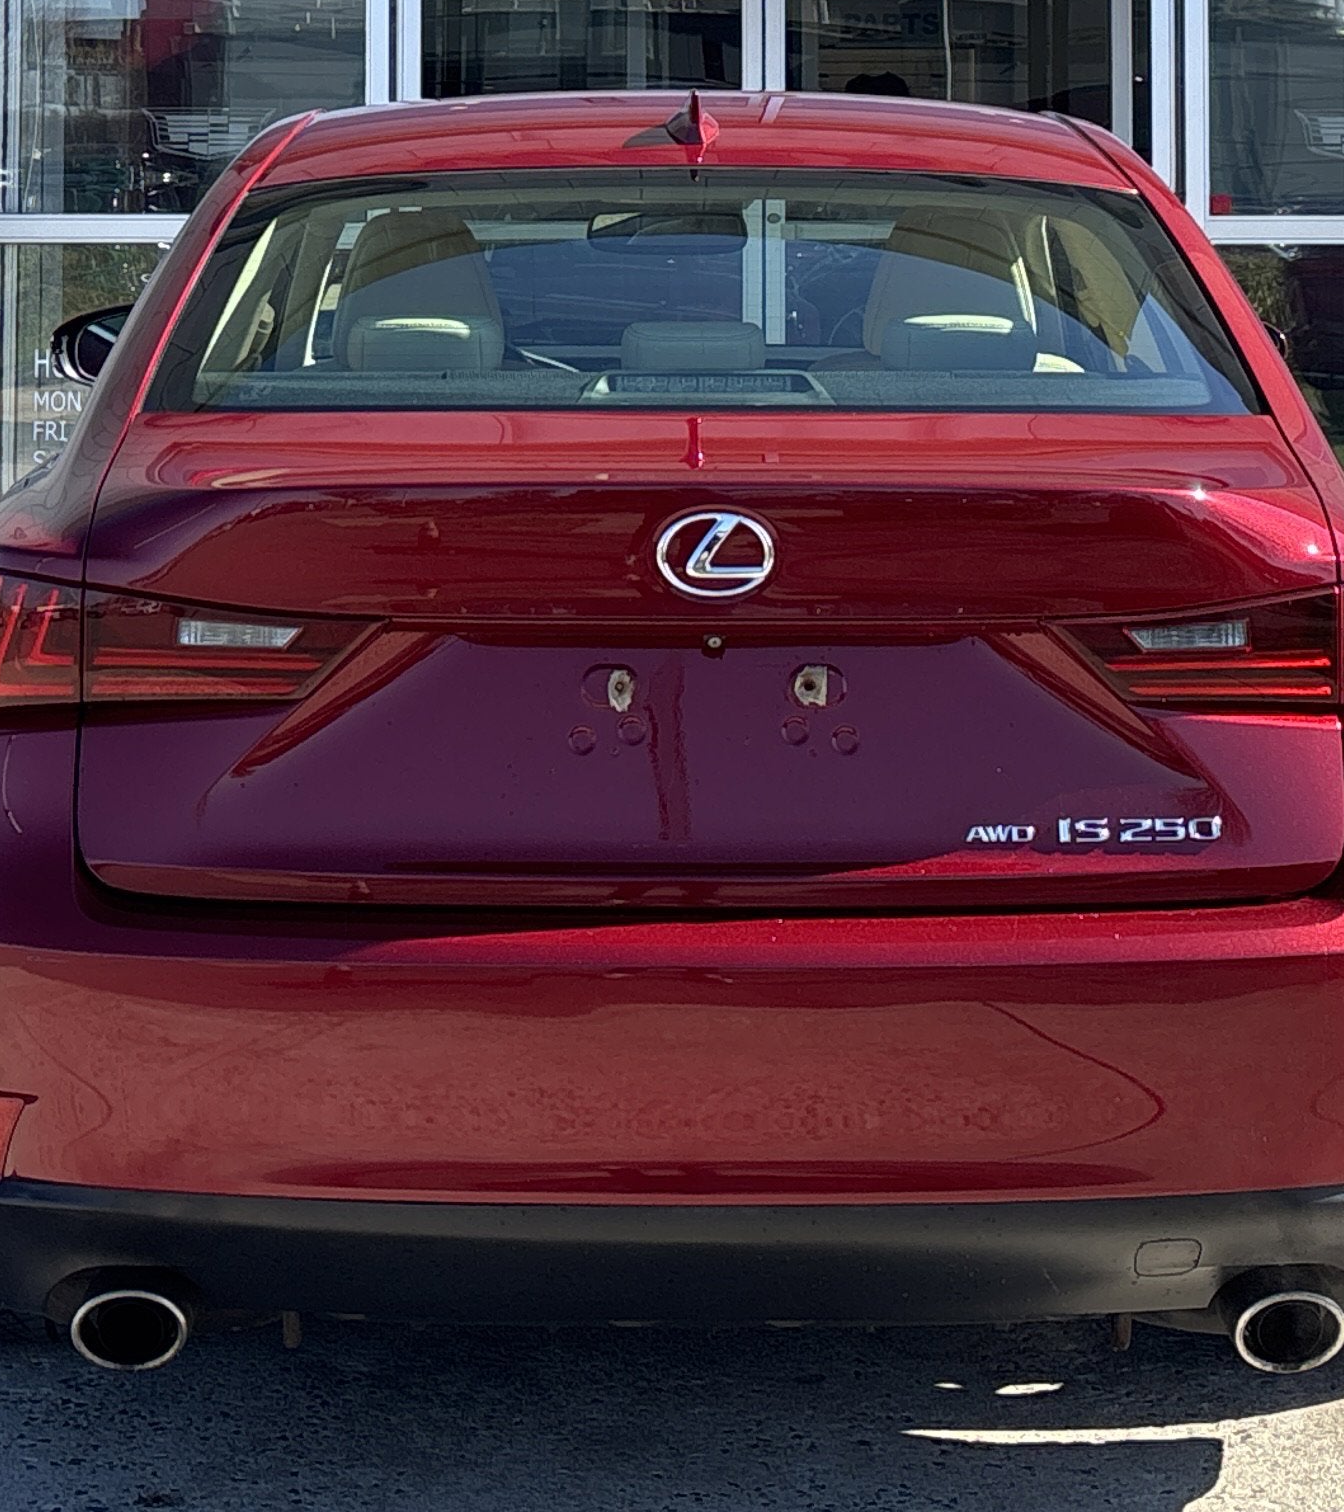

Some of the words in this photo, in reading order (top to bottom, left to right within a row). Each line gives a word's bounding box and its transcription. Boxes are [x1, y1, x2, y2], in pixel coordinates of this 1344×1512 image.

[33, 391, 82, 412] MON
[33, 420, 69, 442] FRI
[965, 824, 1036, 843] AWD
[1058, 817, 1110, 844] IS
[1119, 814, 1222, 843] 250
